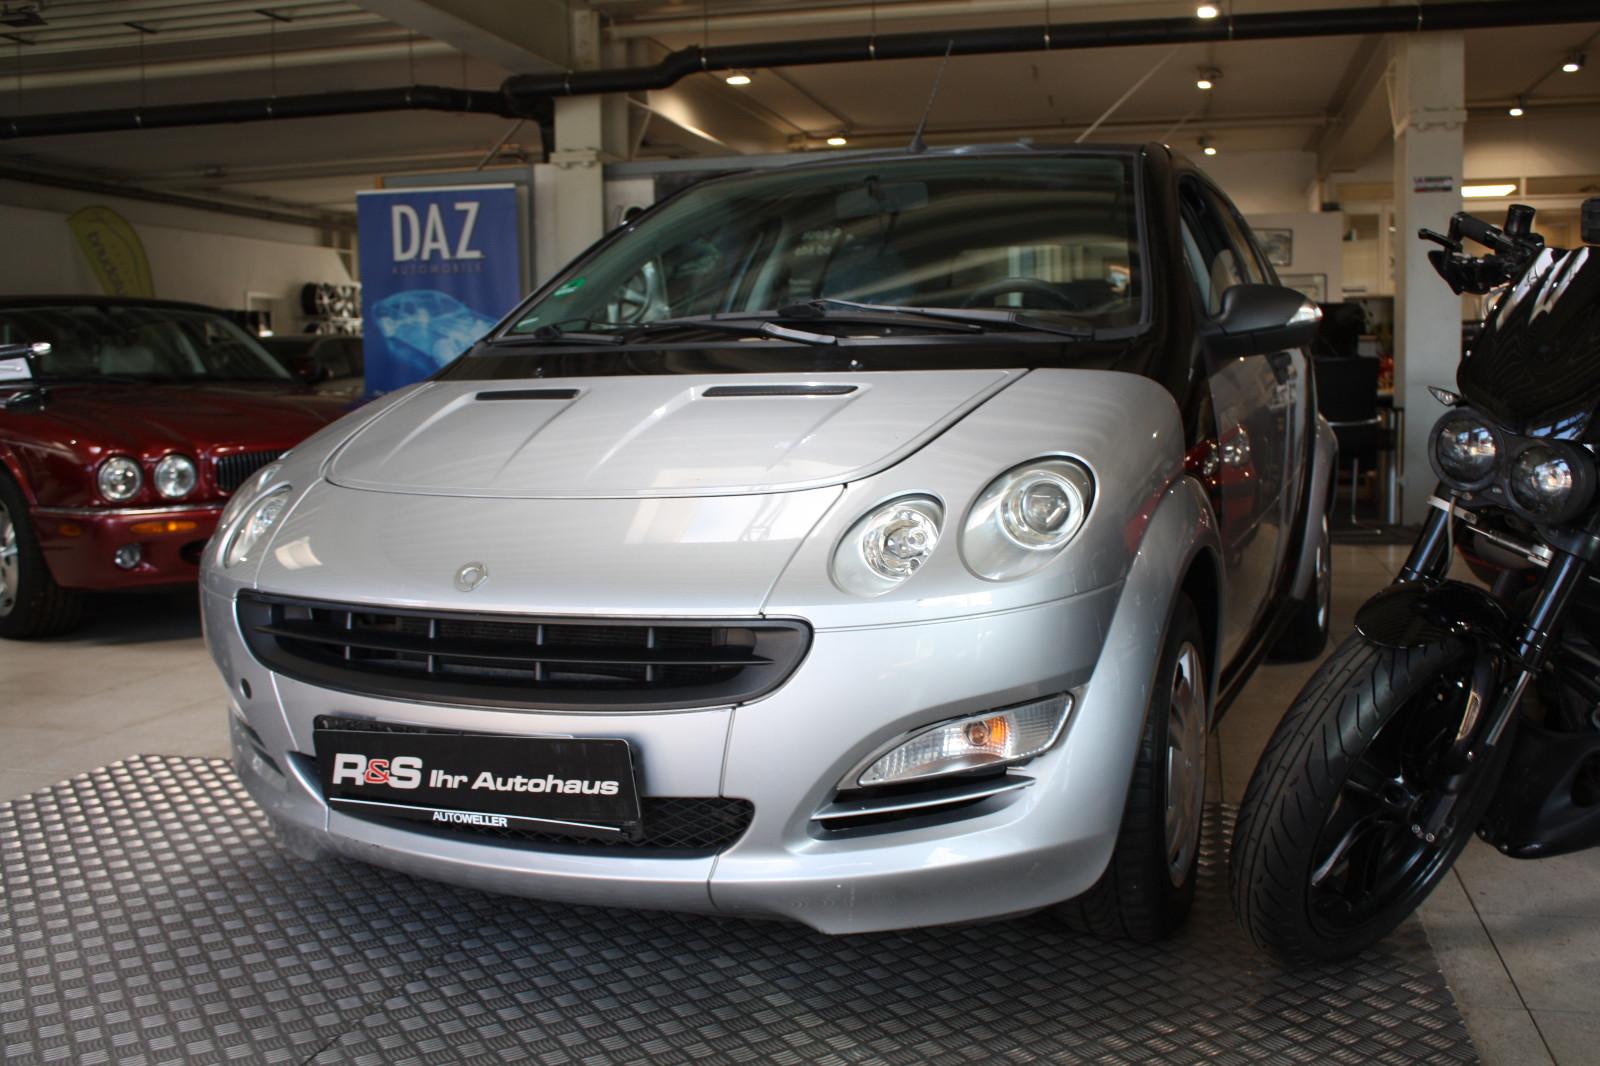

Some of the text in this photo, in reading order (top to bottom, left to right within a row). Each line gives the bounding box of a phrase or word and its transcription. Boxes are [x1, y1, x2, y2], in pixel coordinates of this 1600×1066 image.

[333, 753, 619, 795] R&S Ihr Autohaus
[432, 811, 508, 828] AUTOWELLER
